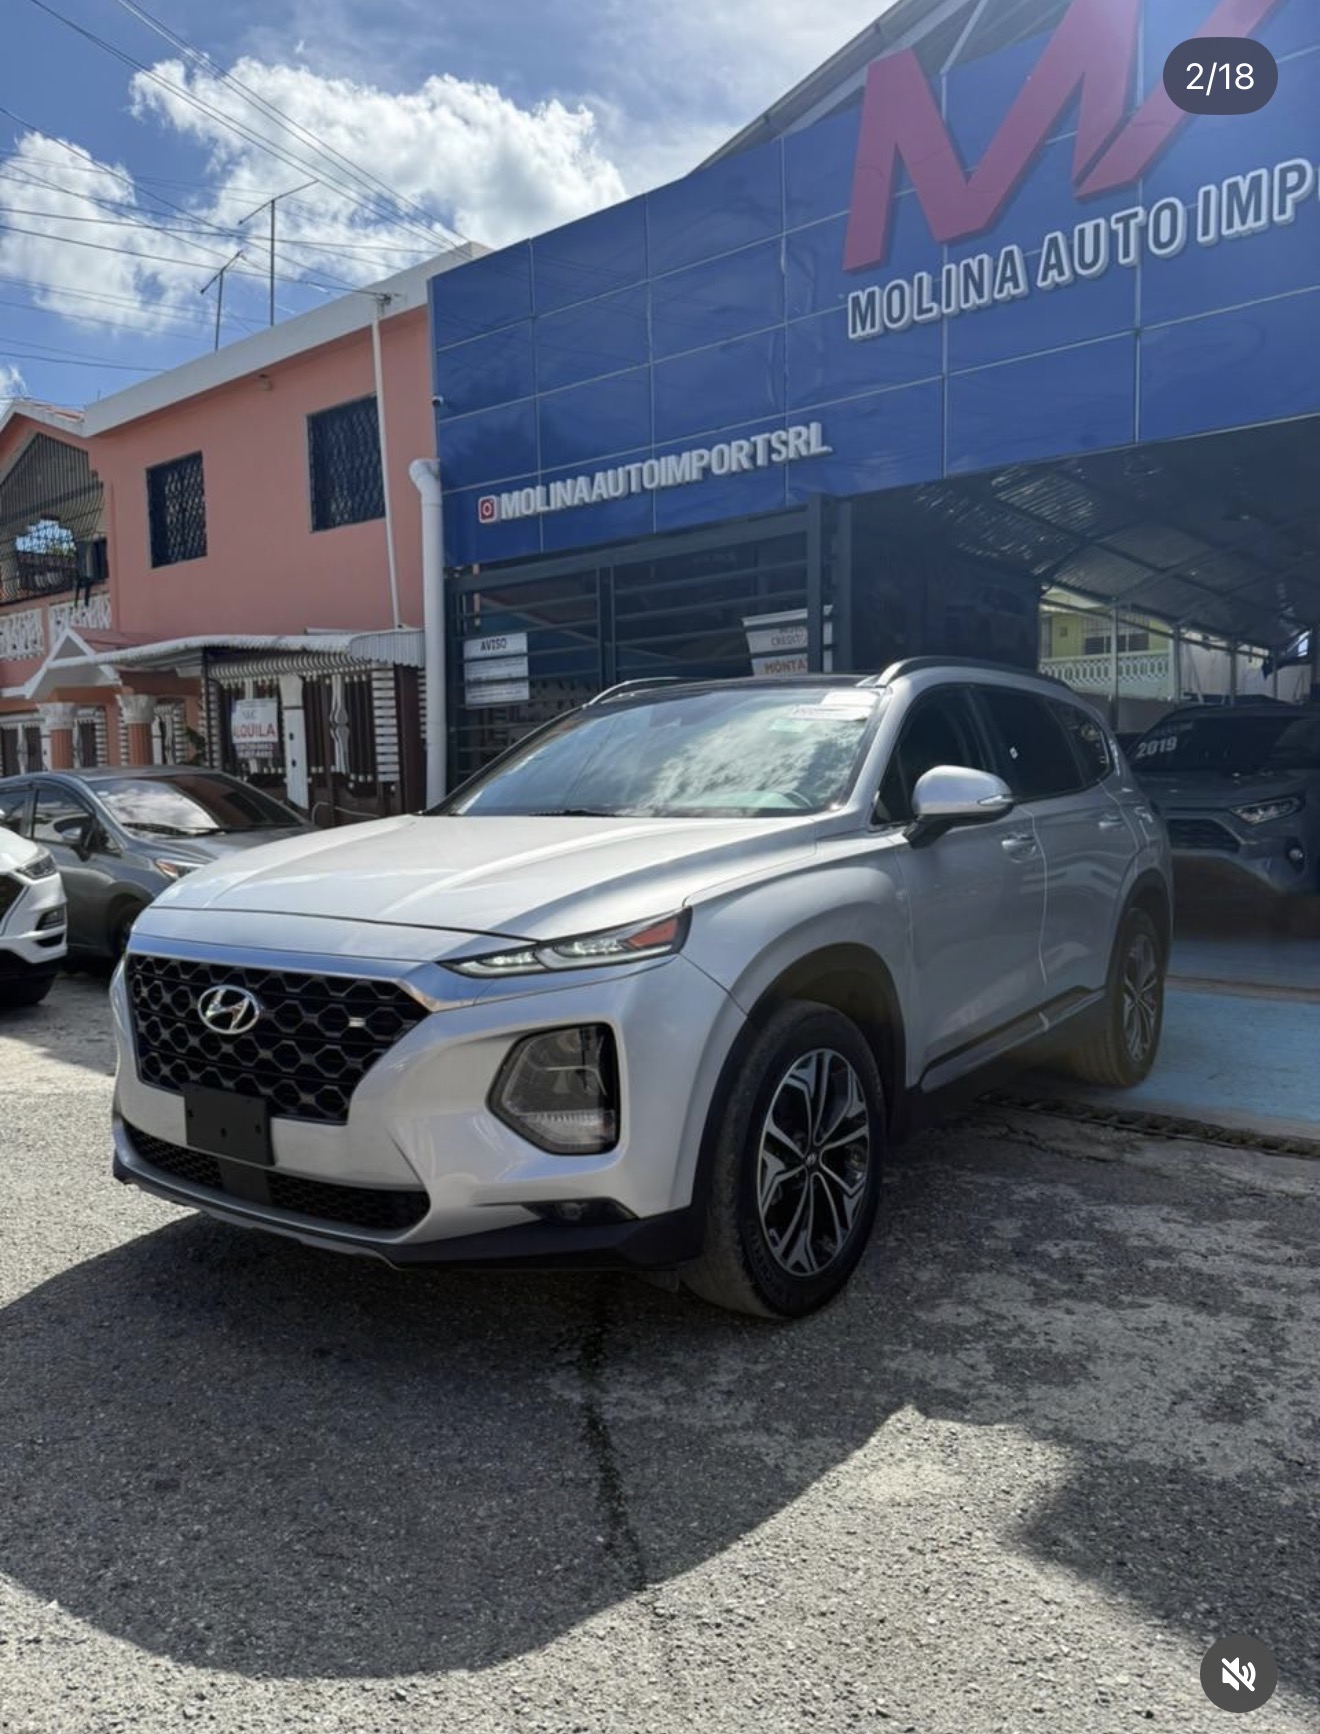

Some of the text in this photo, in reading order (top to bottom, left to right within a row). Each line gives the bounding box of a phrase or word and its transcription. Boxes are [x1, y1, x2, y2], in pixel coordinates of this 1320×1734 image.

[848, 157, 1320, 340] MOLINA AUTO IMP
[500, 421, 833, 520] MOLINAAUTOIMPORTSRL
[481, 637, 507, 651] AVISO
[1136, 735, 1178, 759] 2019
